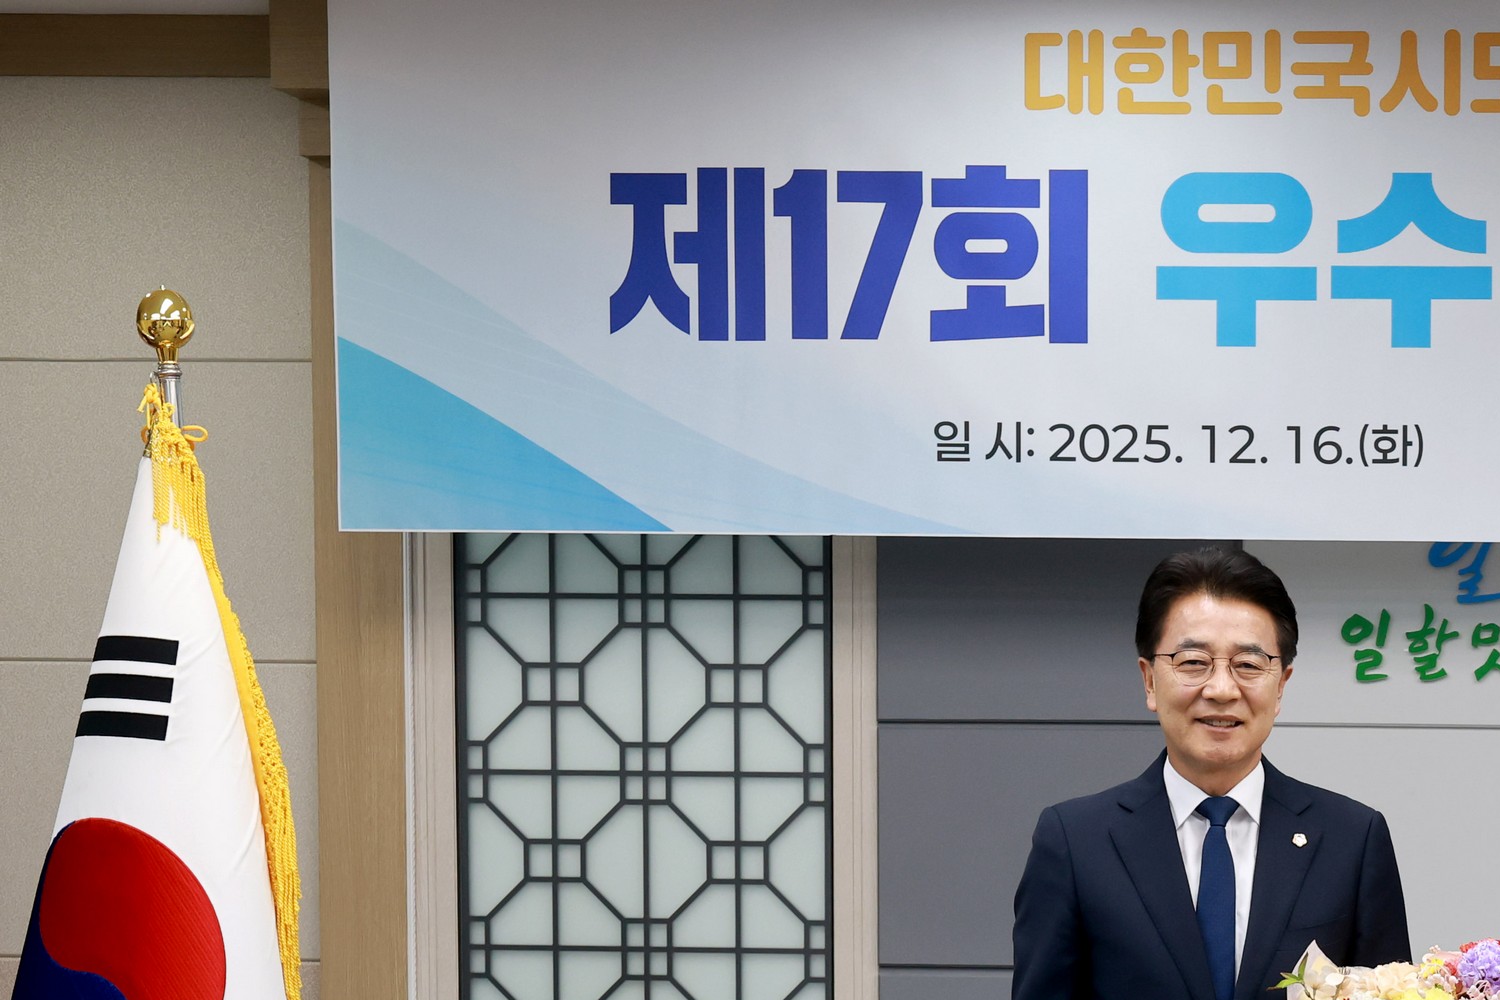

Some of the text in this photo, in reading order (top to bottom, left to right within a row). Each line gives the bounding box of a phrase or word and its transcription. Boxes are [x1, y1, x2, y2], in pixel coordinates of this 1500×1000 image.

[609, 165, 1088, 344] 제17회
[1048, 423, 1183, 464] 2025.
[1201, 424, 1268, 464] 12.
[1286, 423, 1424, 468] 16.(화)
